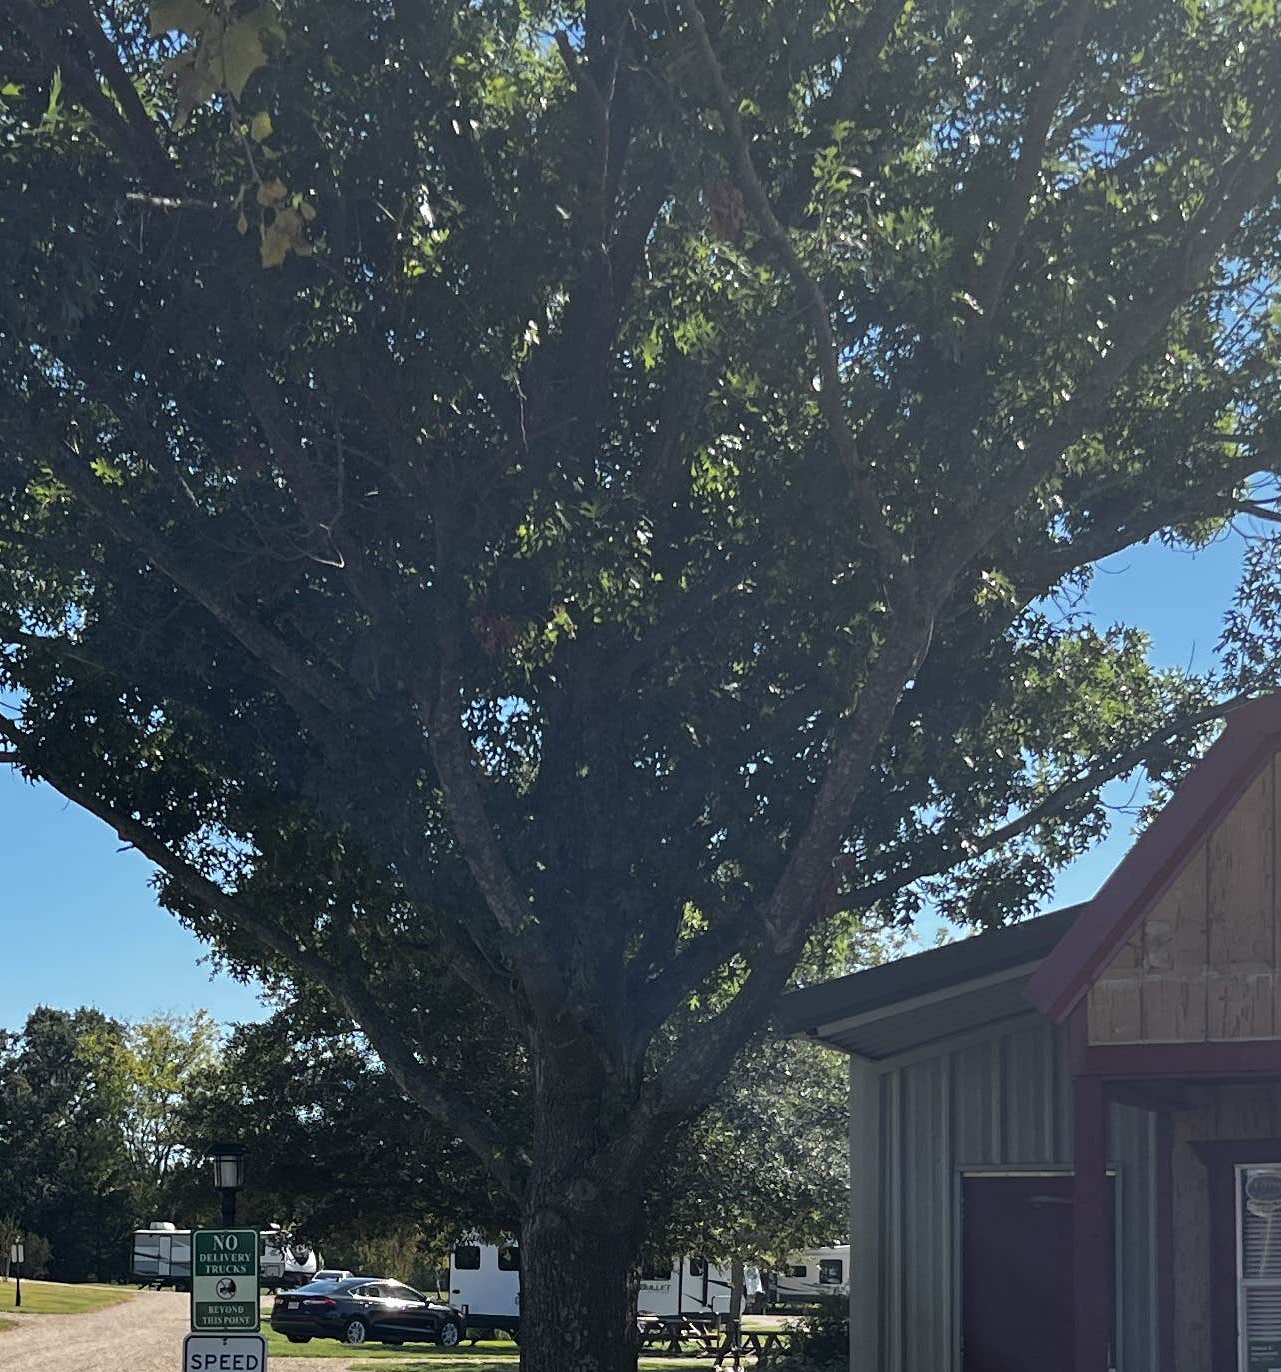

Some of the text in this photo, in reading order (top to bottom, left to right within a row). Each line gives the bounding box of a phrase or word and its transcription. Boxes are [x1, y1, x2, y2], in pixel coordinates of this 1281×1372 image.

[213, 1235, 238, 1251] NO
[199, 1252, 251, 1263] DELIVERY
[206, 1263, 247, 1274] TRUCKS
[208, 1305, 244, 1314] BEYOND
[202, 1315, 250, 1325] THIS POINT
[190, 1354, 259, 1371] SPEED
